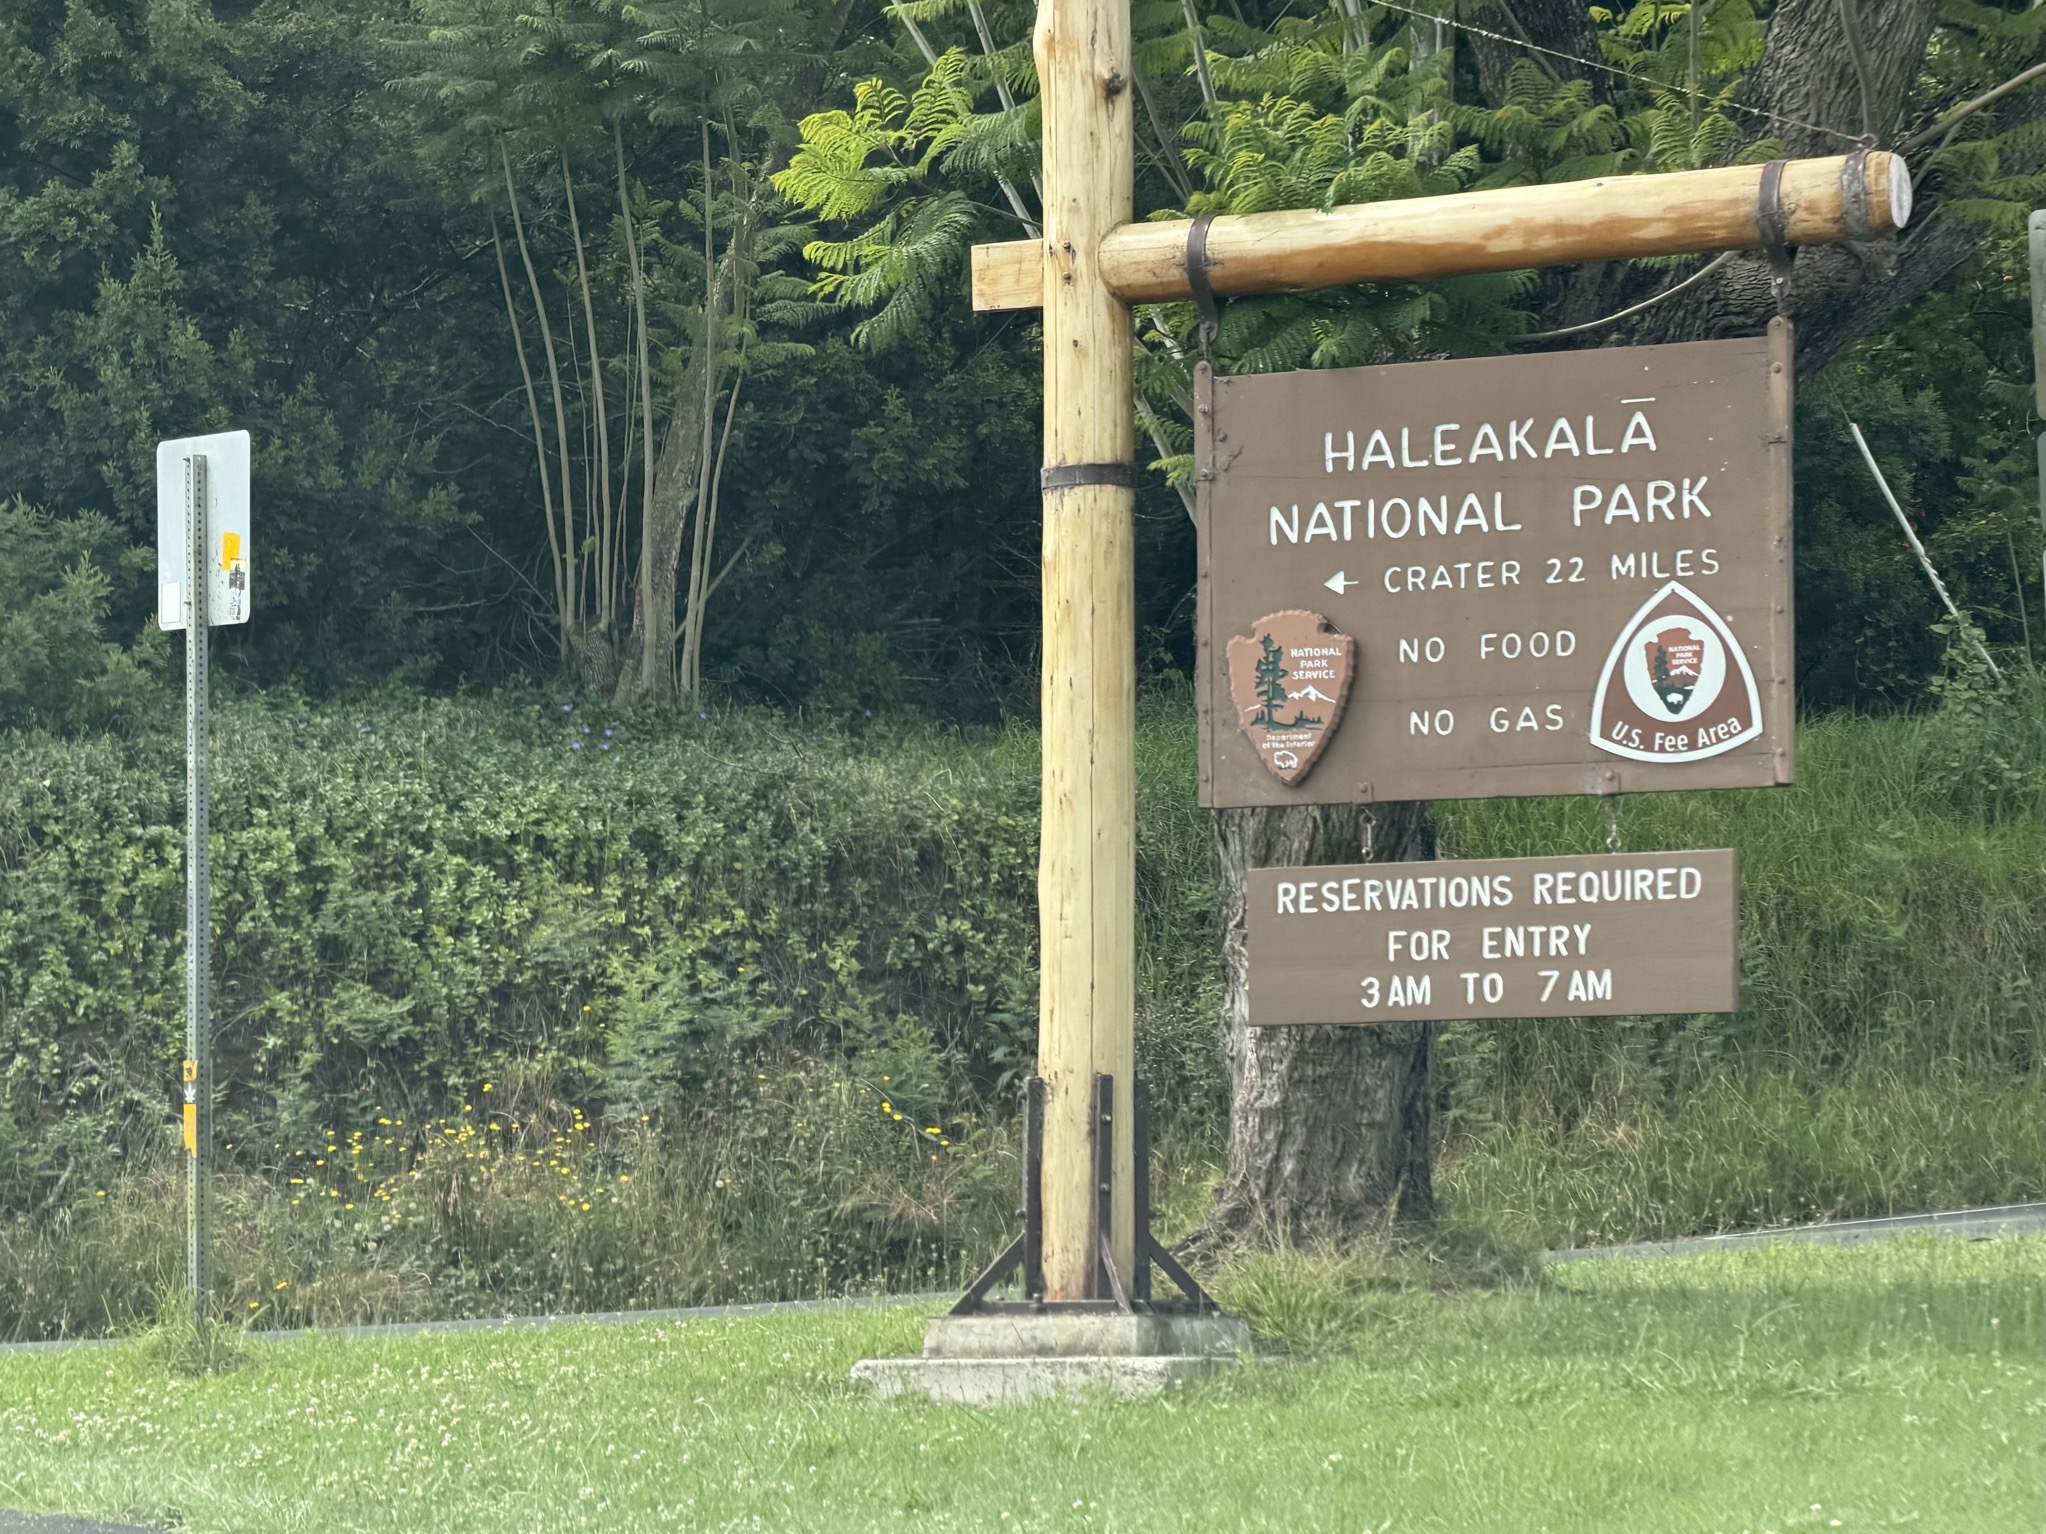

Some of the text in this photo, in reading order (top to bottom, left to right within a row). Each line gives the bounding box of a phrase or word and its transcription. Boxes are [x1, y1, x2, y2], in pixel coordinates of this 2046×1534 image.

[1325, 398, 1656, 472] HALEAKALĀ
[1270, 476, 1711, 545] NATIONAL PARK
[1384, 549, 1719, 592] CRATER 22 MILES
[1290, 647, 1342, 658] NATIONAL
[1400, 631, 1575, 662] NO FOOD
[1292, 670, 1335, 680] SERVICE
[1300, 659, 1328, 668] PARK
[1410, 704, 1563, 735] NO GAS
[1612, 717, 1742, 752] U.S. Fee Area
[1278, 868, 1701, 914] RESERVATIONS REQUIRED
[1389, 924, 1591, 961] FOR ENTRY
[1460, 973, 1503, 1004] TO
